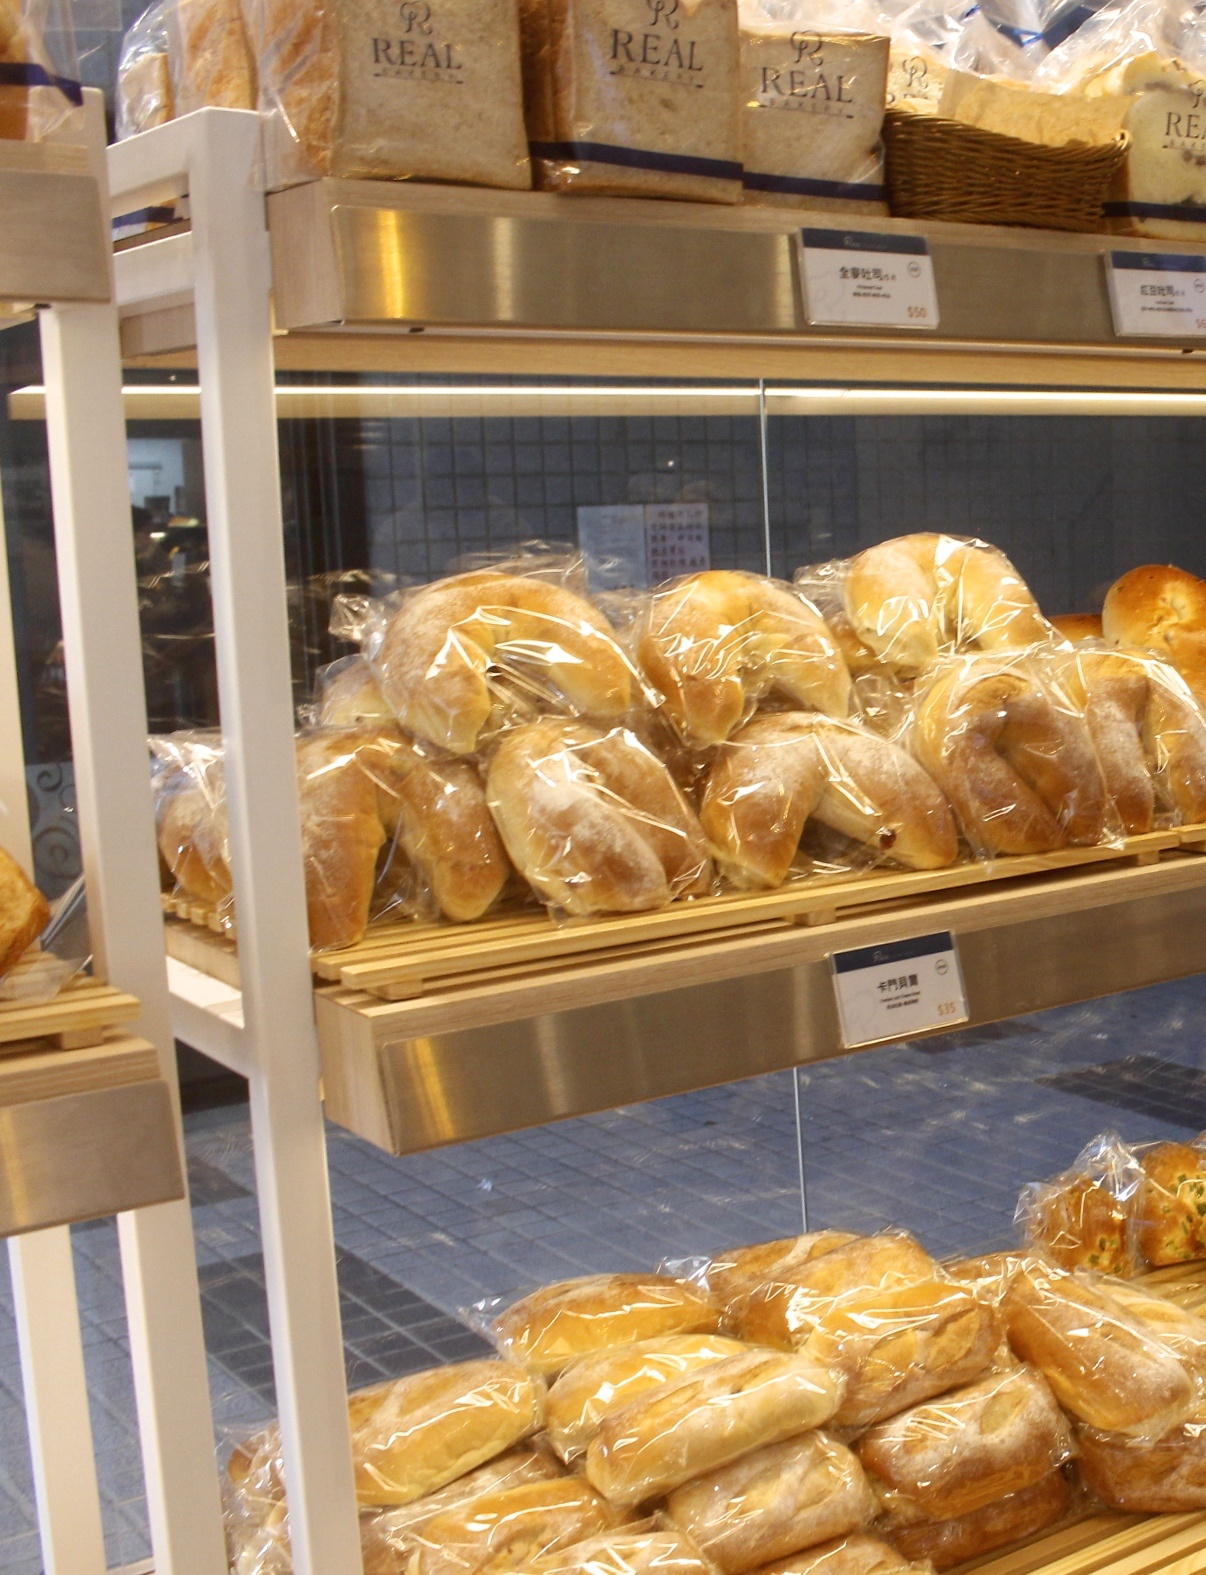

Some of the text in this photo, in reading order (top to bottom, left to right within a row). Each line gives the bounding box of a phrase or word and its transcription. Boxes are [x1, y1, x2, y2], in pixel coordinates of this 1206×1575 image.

[371, 38, 462, 69] REAL
[611, 29, 703, 71] REAL
[760, 67, 852, 103] REAL
[937, 1002, 956, 1016] $35
